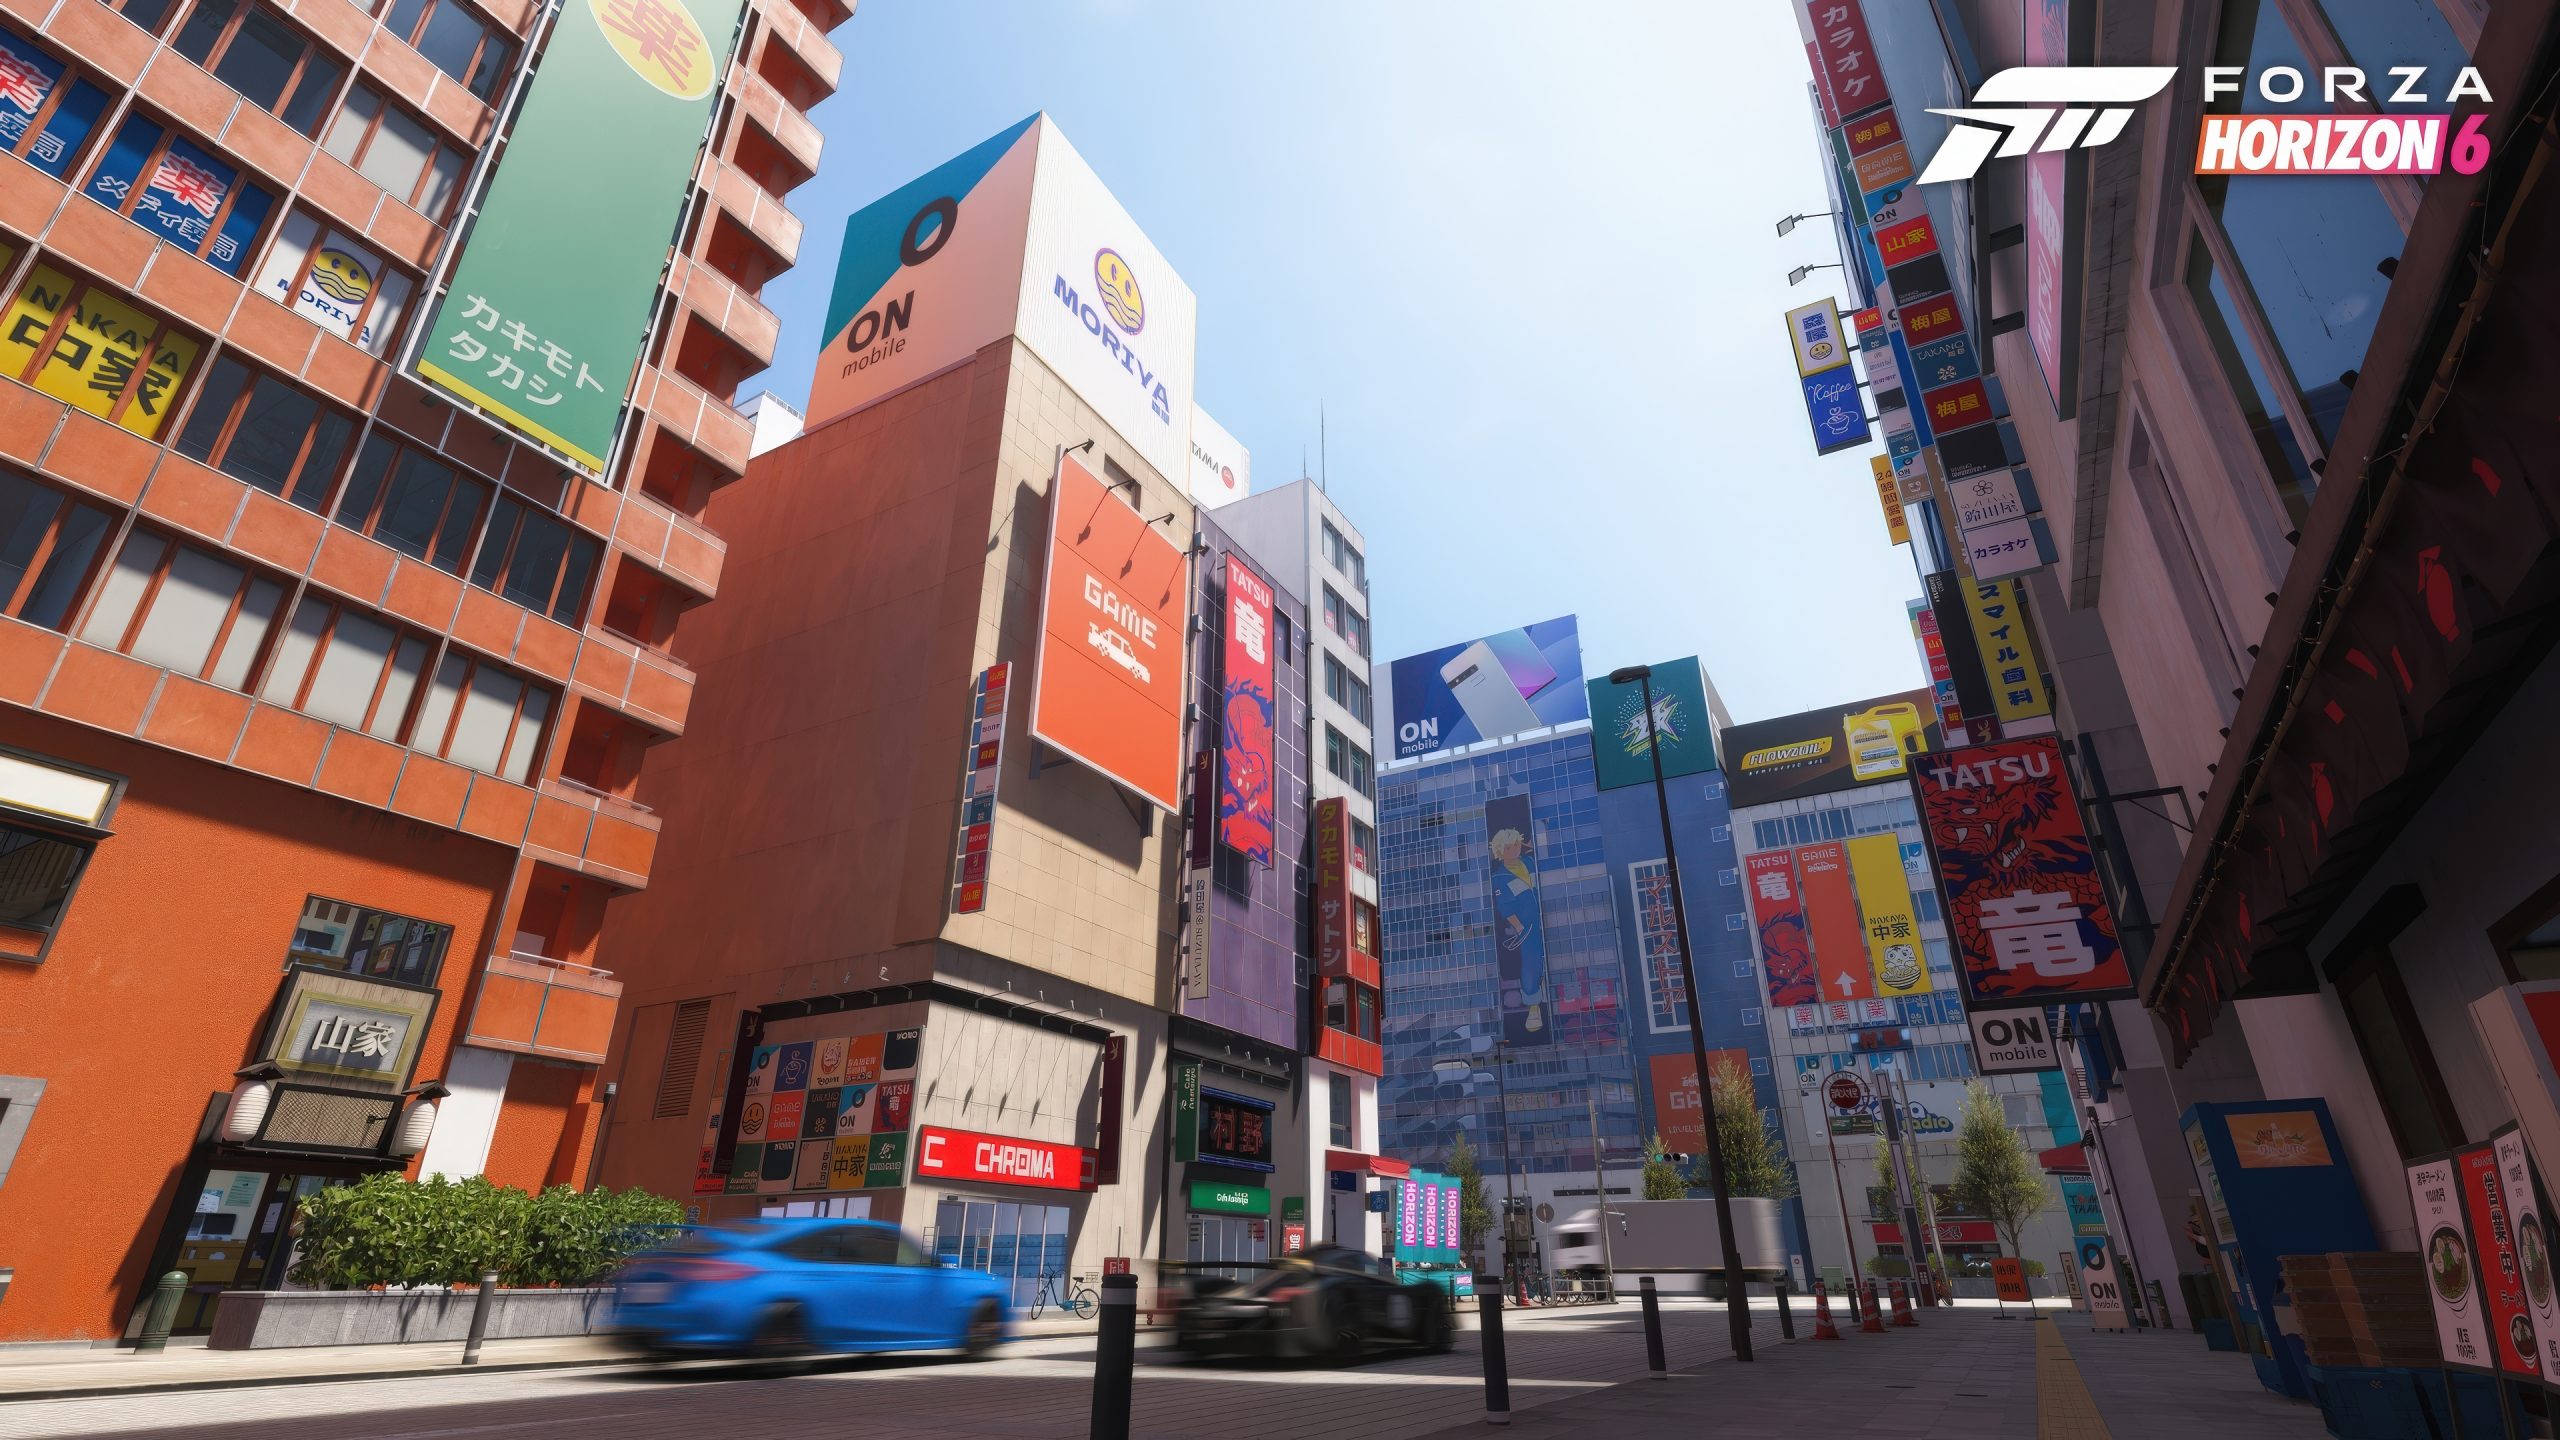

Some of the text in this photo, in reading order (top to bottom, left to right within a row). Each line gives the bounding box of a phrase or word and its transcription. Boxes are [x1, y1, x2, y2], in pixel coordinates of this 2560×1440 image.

[1822, 5, 1871, 97] カラオケ
[1874, 208, 1898, 223] ON
[277, 278, 371, 338] MORIYA
[847, 290, 915, 353] ON
[28, 285, 180, 375] NAKAYA
[461, 293, 604, 393] カキモト
[1054, 273, 1170, 414] MORIYA
[8, 314, 173, 416] 中家
[448, 329, 564, 407] タカシ
[842, 338, 906, 379] mobile
[1974, 538, 2029, 560] カラオケ
[1229, 562, 1271, 610] TATSU
[1084, 573, 1159, 650] GAME
[1232, 597, 1267, 667] 竜
[1400, 717, 1439, 744] ON
[1402, 737, 1439, 755] mobile
[1929, 751, 2051, 792] TATSU
[1750, 855, 1789, 869] TATSU
[1802, 848, 1838, 862] GAME
[1320, 804, 1341, 967] タカモト サトシ
[1756, 871, 1792, 901] 竜
[1869, 914, 1908, 925] NAKAYA
[1872, 922, 1911, 940] 中家
[1979, 889, 2096, 977] 竜
[311, 1015, 396, 1057] 山家
[1981, 1015, 2043, 1050] ON
[1989, 1047, 2047, 1063] mobile
[882, 1084, 910, 1097] TATSU
[1801, 1073, 1816, 1083] ON
[839, 1114, 856, 1128] ON
[833, 1154, 865, 1178] 中家
[975, 1142, 1054, 1179] CHROMA
[1405, 1183, 1417, 1244] HORIZON
[1426, 1187, 1437, 1246] HORIZON
[1447, 1190, 1457, 1247] HORIZON
[2090, 1282, 2116, 1299] ON
